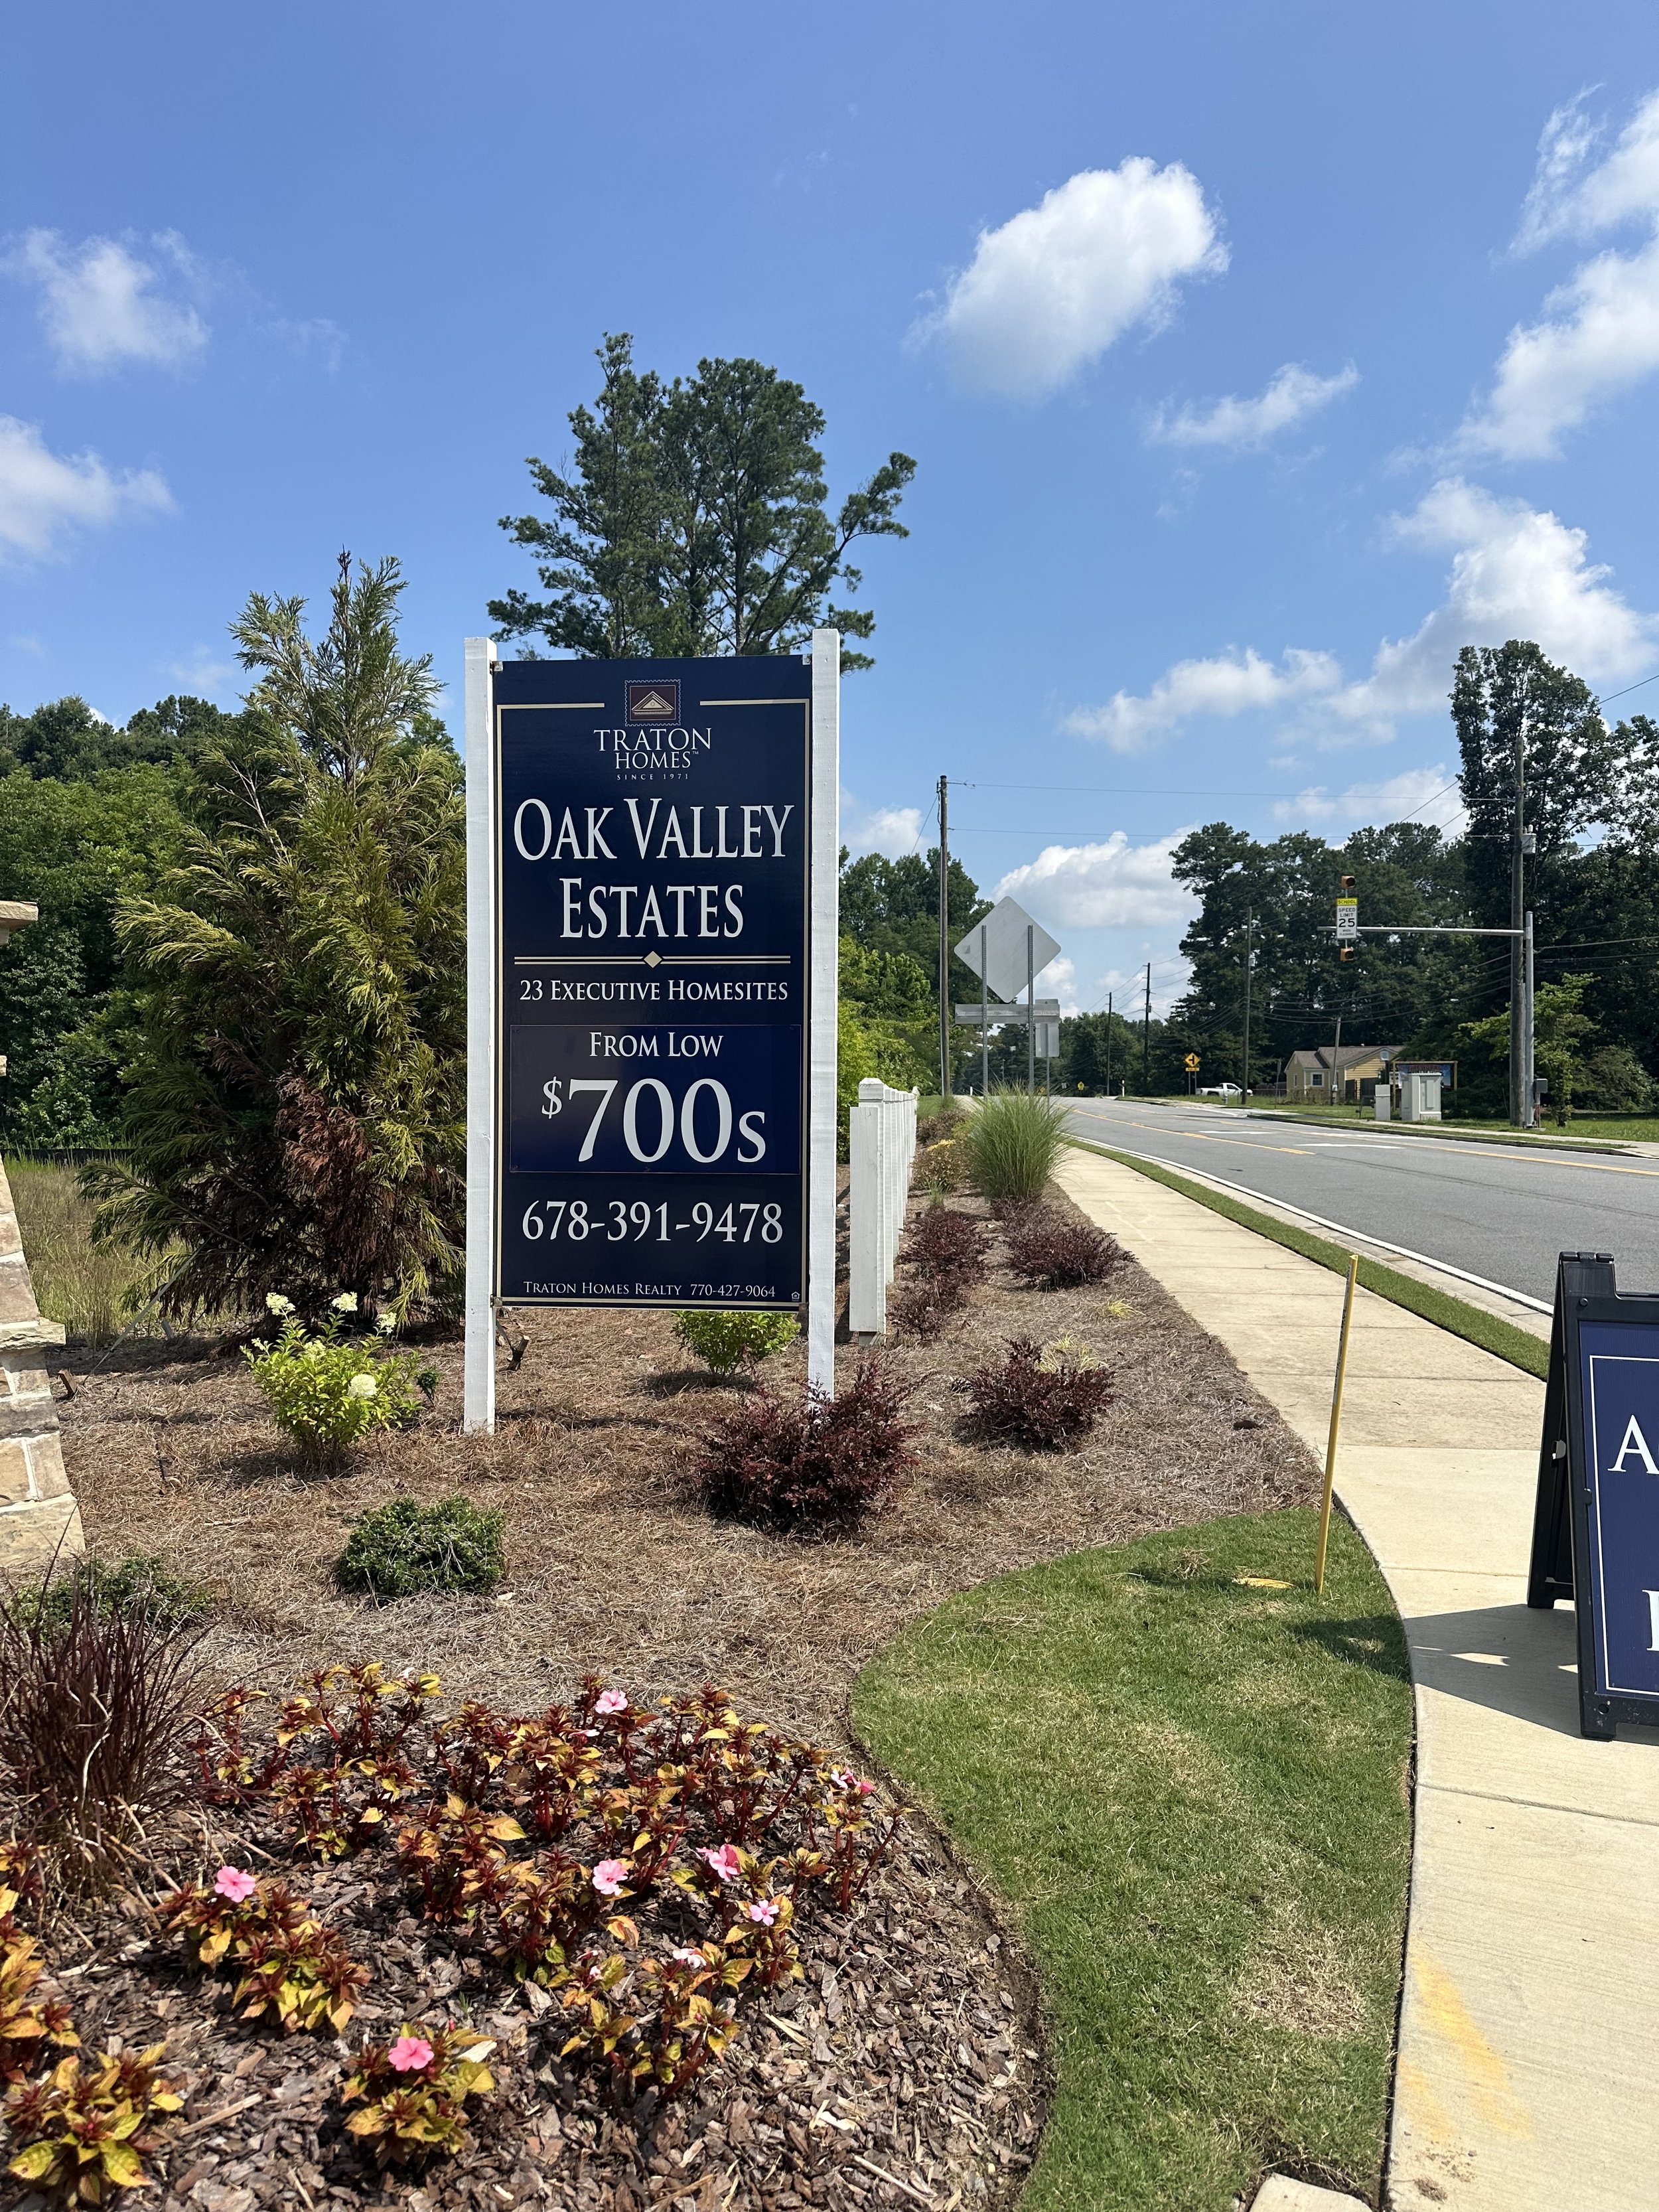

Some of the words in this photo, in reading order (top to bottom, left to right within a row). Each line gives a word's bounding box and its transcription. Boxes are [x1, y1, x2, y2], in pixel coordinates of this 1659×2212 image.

[593, 727, 712, 751] TRATON
[614, 751, 691, 770] HOMES
[514, 798, 617, 861] OAK
[624, 798, 795, 859] VALLEY
[559, 877, 744, 938] ESTATES
[1338, 918, 1355, 928] 25
[520, 980, 543, 1001] 23
[550, 980, 660, 1001] EXECUTIVE
[668, 980, 788, 1001] HOMESITES
[589, 1031, 660, 1057] FROM
[668, 1032, 724, 1057] LOW
[522, 1200, 783, 1243] 678-391-9478
[523, 1281, 576, 1295] TRATON
[582, 1282, 629, 1295] HOMES
[635, 1283, 682, 1295] REALTY
[690, 1284, 776, 1297] 770-427-9064
